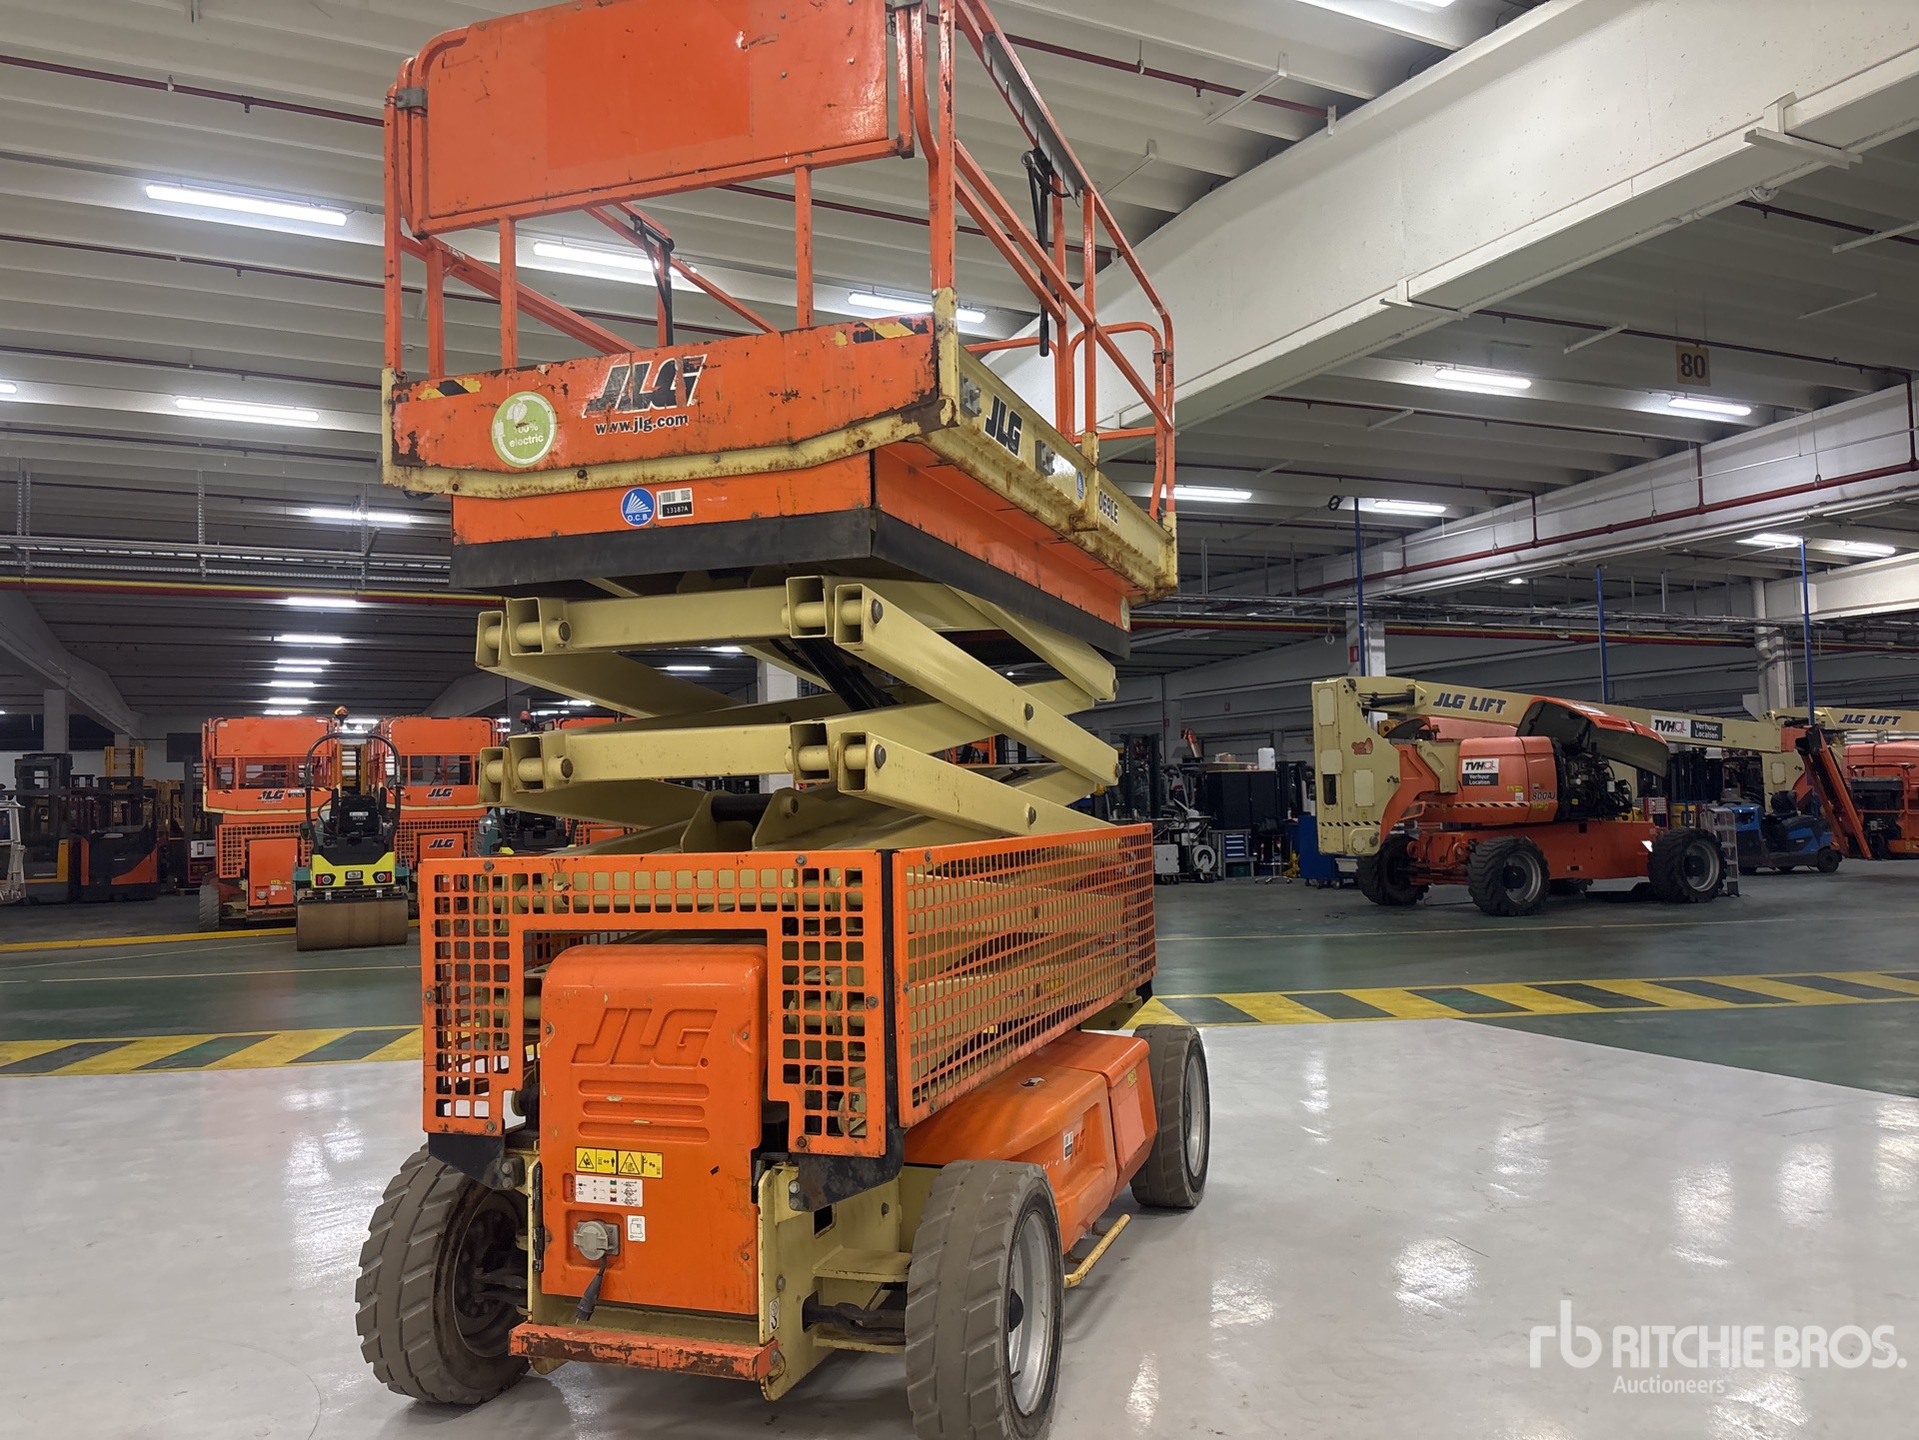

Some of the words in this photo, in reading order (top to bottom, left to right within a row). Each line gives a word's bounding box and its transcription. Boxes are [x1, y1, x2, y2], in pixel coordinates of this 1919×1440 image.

[1680, 352, 1706, 379] 80
[983, 393, 1024, 458] JLG
[509, 434, 544, 447] electric
[1433, 692, 1466, 709] JLG
[1468, 696, 1507, 714] LIFT
[1654, 719, 1675, 733] TVH
[1694, 721, 1719, 731] Verhuur
[1839, 713, 1866, 725] JLG
[1868, 714, 1902, 726] LIFT
[1694, 730, 1719, 740] Location
[1465, 761, 1484, 771] TVH
[427, 787, 453, 798] JLG
[428, 838, 456, 849] JLG
[570, 1007, 719, 1068] JLG
